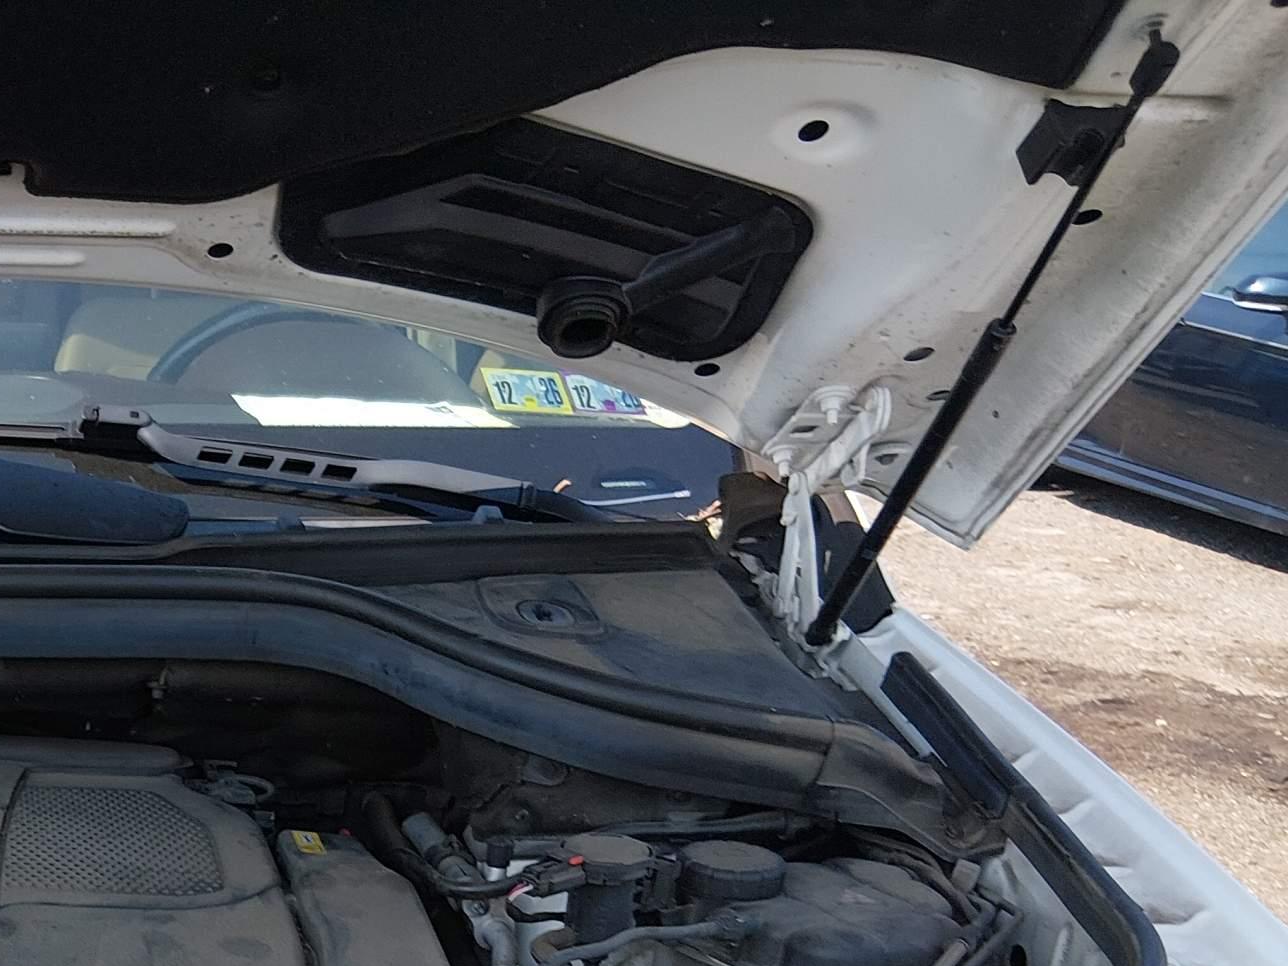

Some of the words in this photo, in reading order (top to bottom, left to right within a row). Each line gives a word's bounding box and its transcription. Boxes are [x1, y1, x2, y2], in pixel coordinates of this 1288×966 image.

[493, 380, 518, 406] 12
[539, 377, 564, 406] 26
[571, 384, 596, 409] 12
